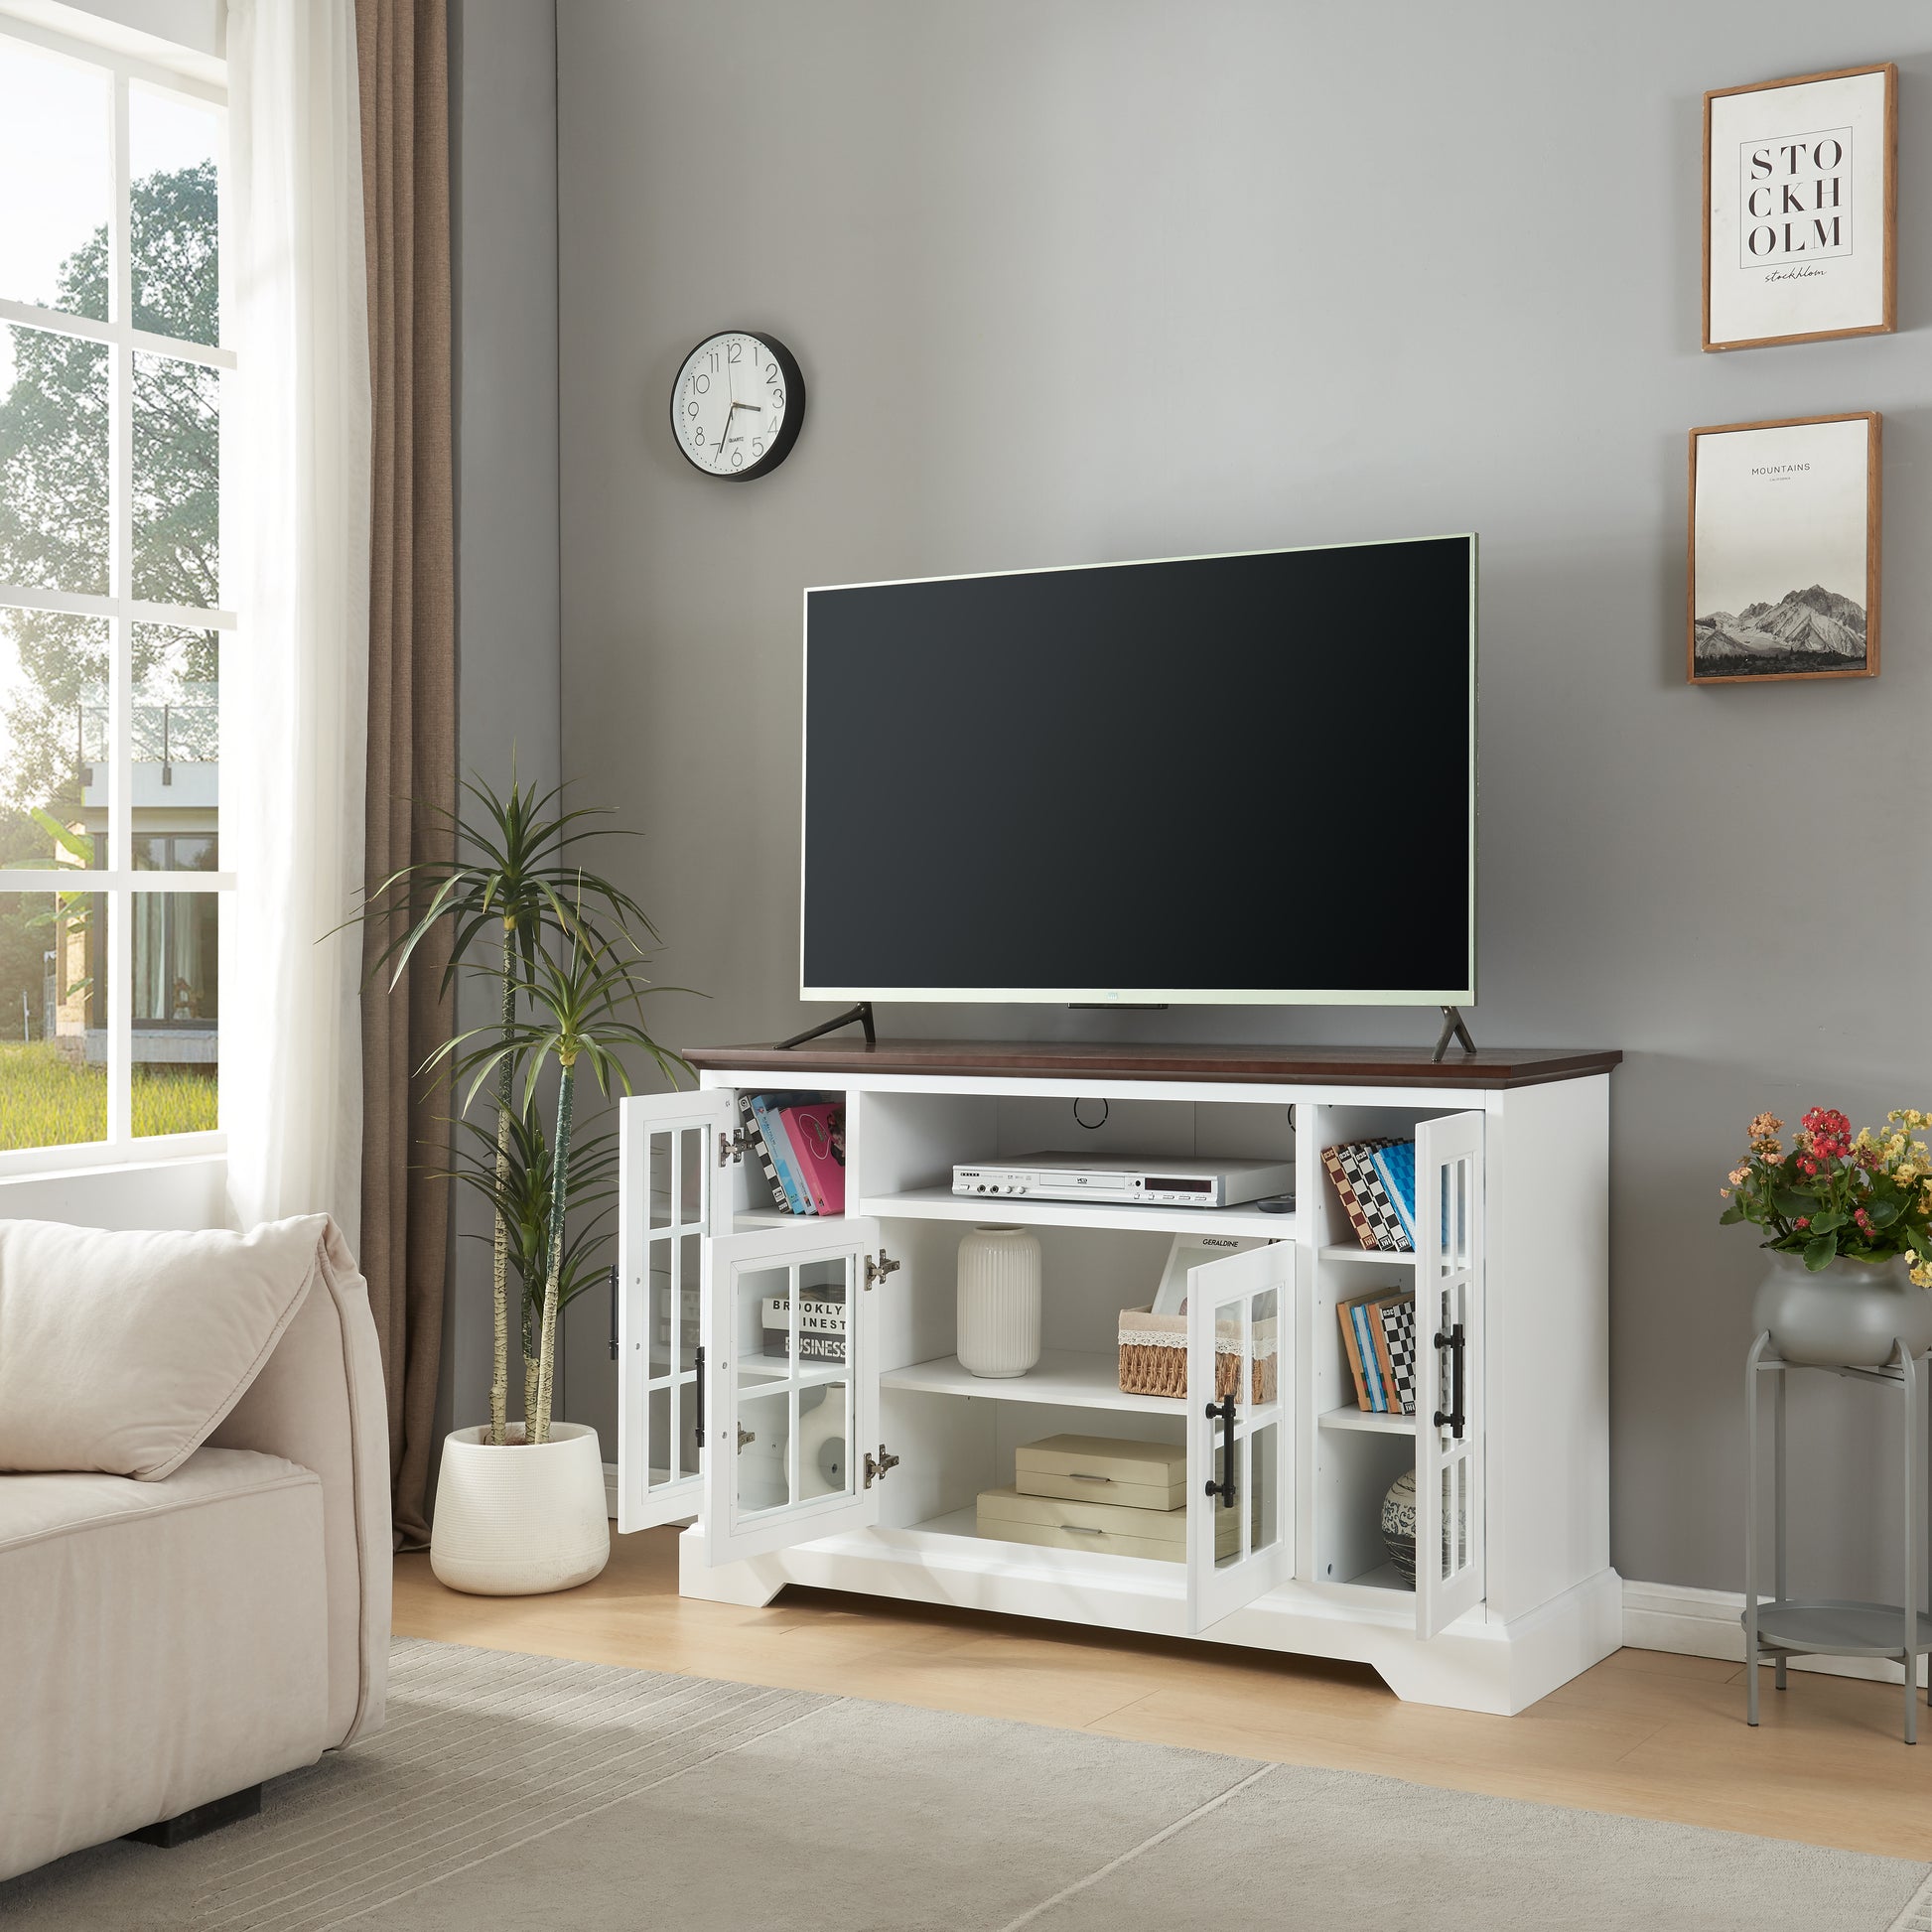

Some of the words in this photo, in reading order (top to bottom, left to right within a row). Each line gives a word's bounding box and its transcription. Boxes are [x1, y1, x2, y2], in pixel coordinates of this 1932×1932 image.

[1750, 139, 1843, 180] STO
[1748, 177, 1843, 217] CKH
[1748, 215, 1844, 256] OLM
[709, 352, 720, 373] 11
[726, 343, 743, 364] 12
[754, 346, 759, 366] 1
[765, 363, 778, 384] 2
[691, 374, 711, 395] 10
[772, 388, 784, 408] 3
[687, 401, 700, 421] 9
[767, 415, 778, 435] 4
[695, 426, 706, 446] 8
[709, 442, 722, 464] 7
[752, 437, 764, 457] 5
[731, 447, 743, 468] 6
[1751, 463, 1811, 476] MOUNTAINS
[1202, 1238, 1239, 1248] GERALDINE
[772, 1300, 843, 1315] BROKLY
[802, 1316, 847, 1330] INEST
